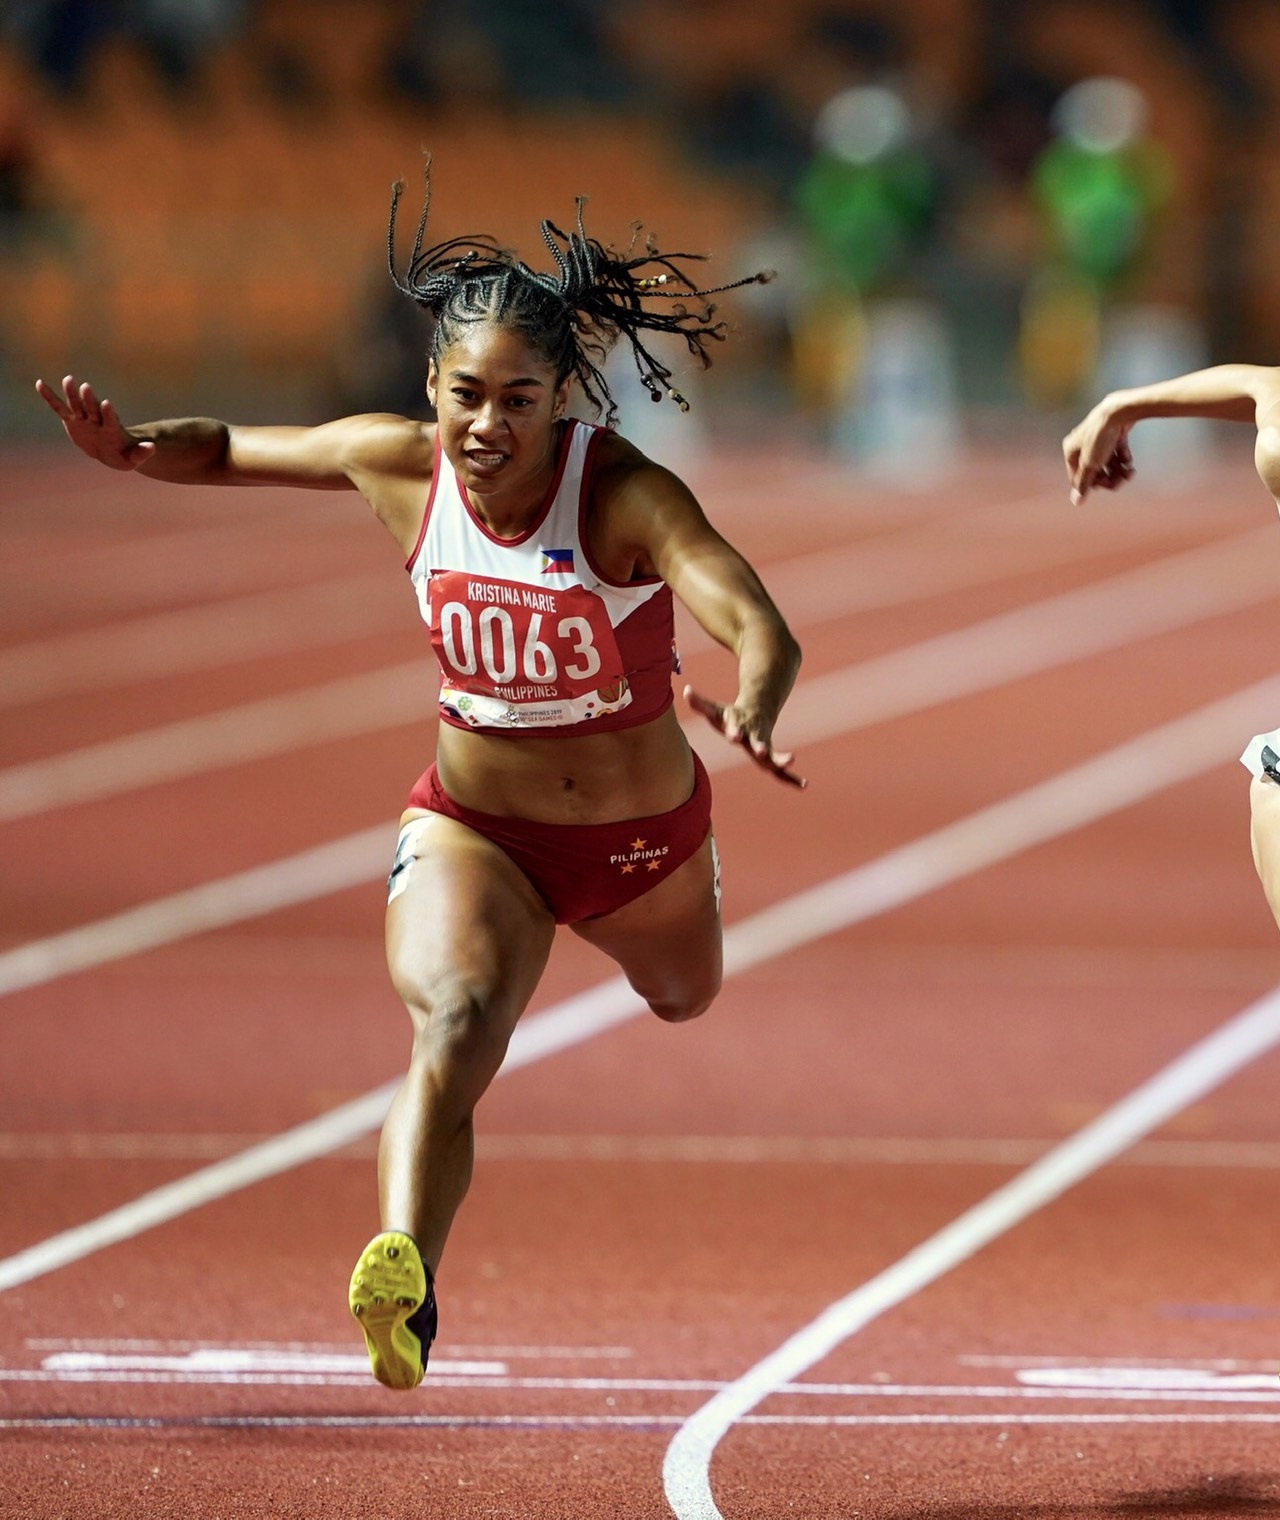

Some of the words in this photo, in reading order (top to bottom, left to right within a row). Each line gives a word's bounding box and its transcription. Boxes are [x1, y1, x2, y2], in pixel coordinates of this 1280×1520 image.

[467, 581, 521, 605] KRISTINA
[521, 590, 557, 613] MARIE
[440, 601, 602, 684] 0063
[494, 685, 558, 700] PHILIPPINES
[610, 846, 669, 864] PILIPINAS
